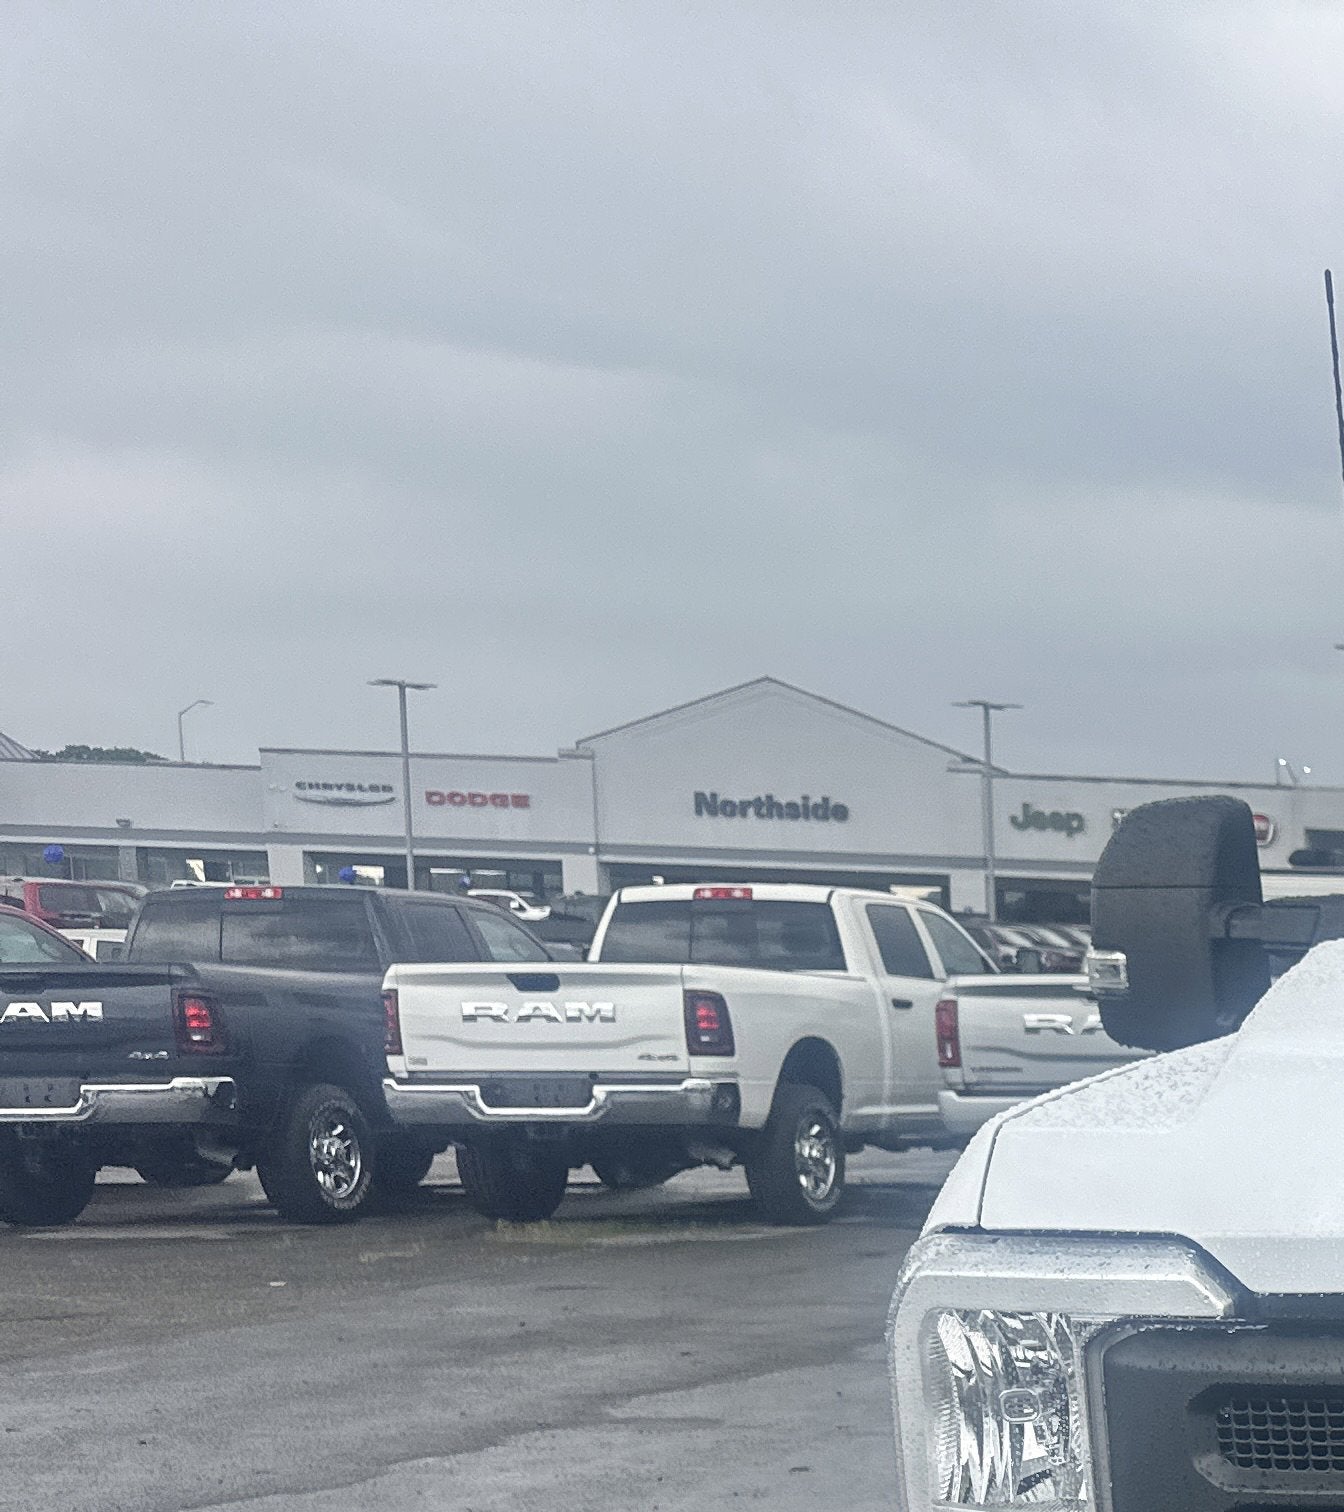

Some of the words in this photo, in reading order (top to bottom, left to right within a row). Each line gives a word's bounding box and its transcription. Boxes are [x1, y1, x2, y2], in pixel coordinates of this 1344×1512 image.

[295, 781, 394, 793] CHRYSLER
[425, 790, 530, 809] DODGE
[693, 791, 849, 823] Northside
[1010, 803, 1084, 838] Jeep
[0, 1002, 104, 1023] AM
[461, 1001, 616, 1024] RAM
